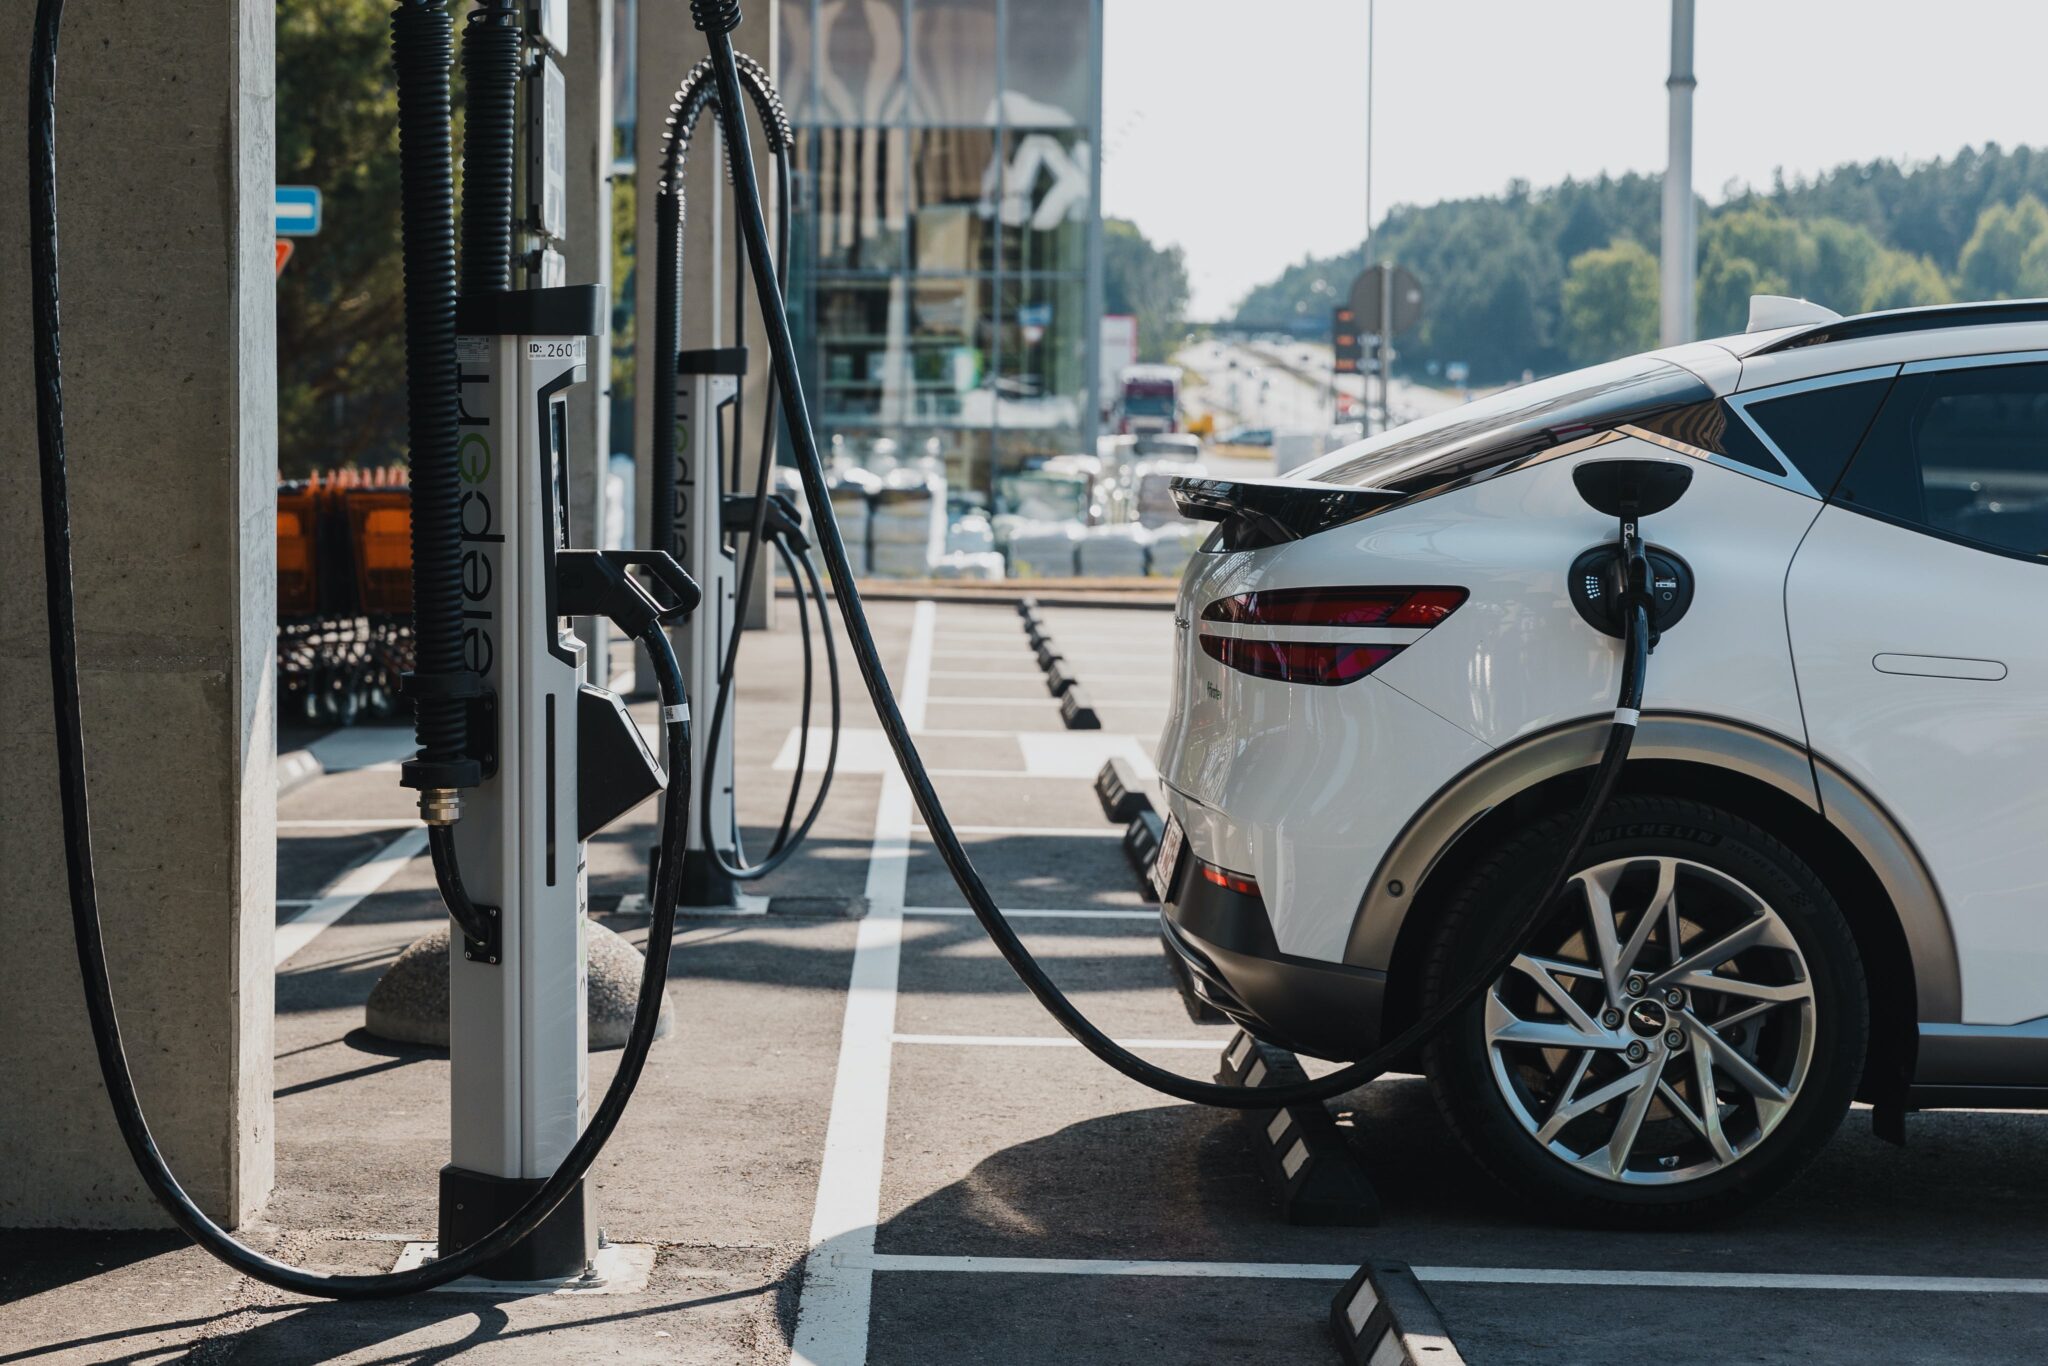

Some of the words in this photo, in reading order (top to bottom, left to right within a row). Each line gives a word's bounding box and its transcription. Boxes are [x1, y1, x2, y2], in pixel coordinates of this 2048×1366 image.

[529, 343, 542, 353] ID:
[458, 364, 505, 678] eleport
[1594, 823, 1715, 844] MICHELIN
